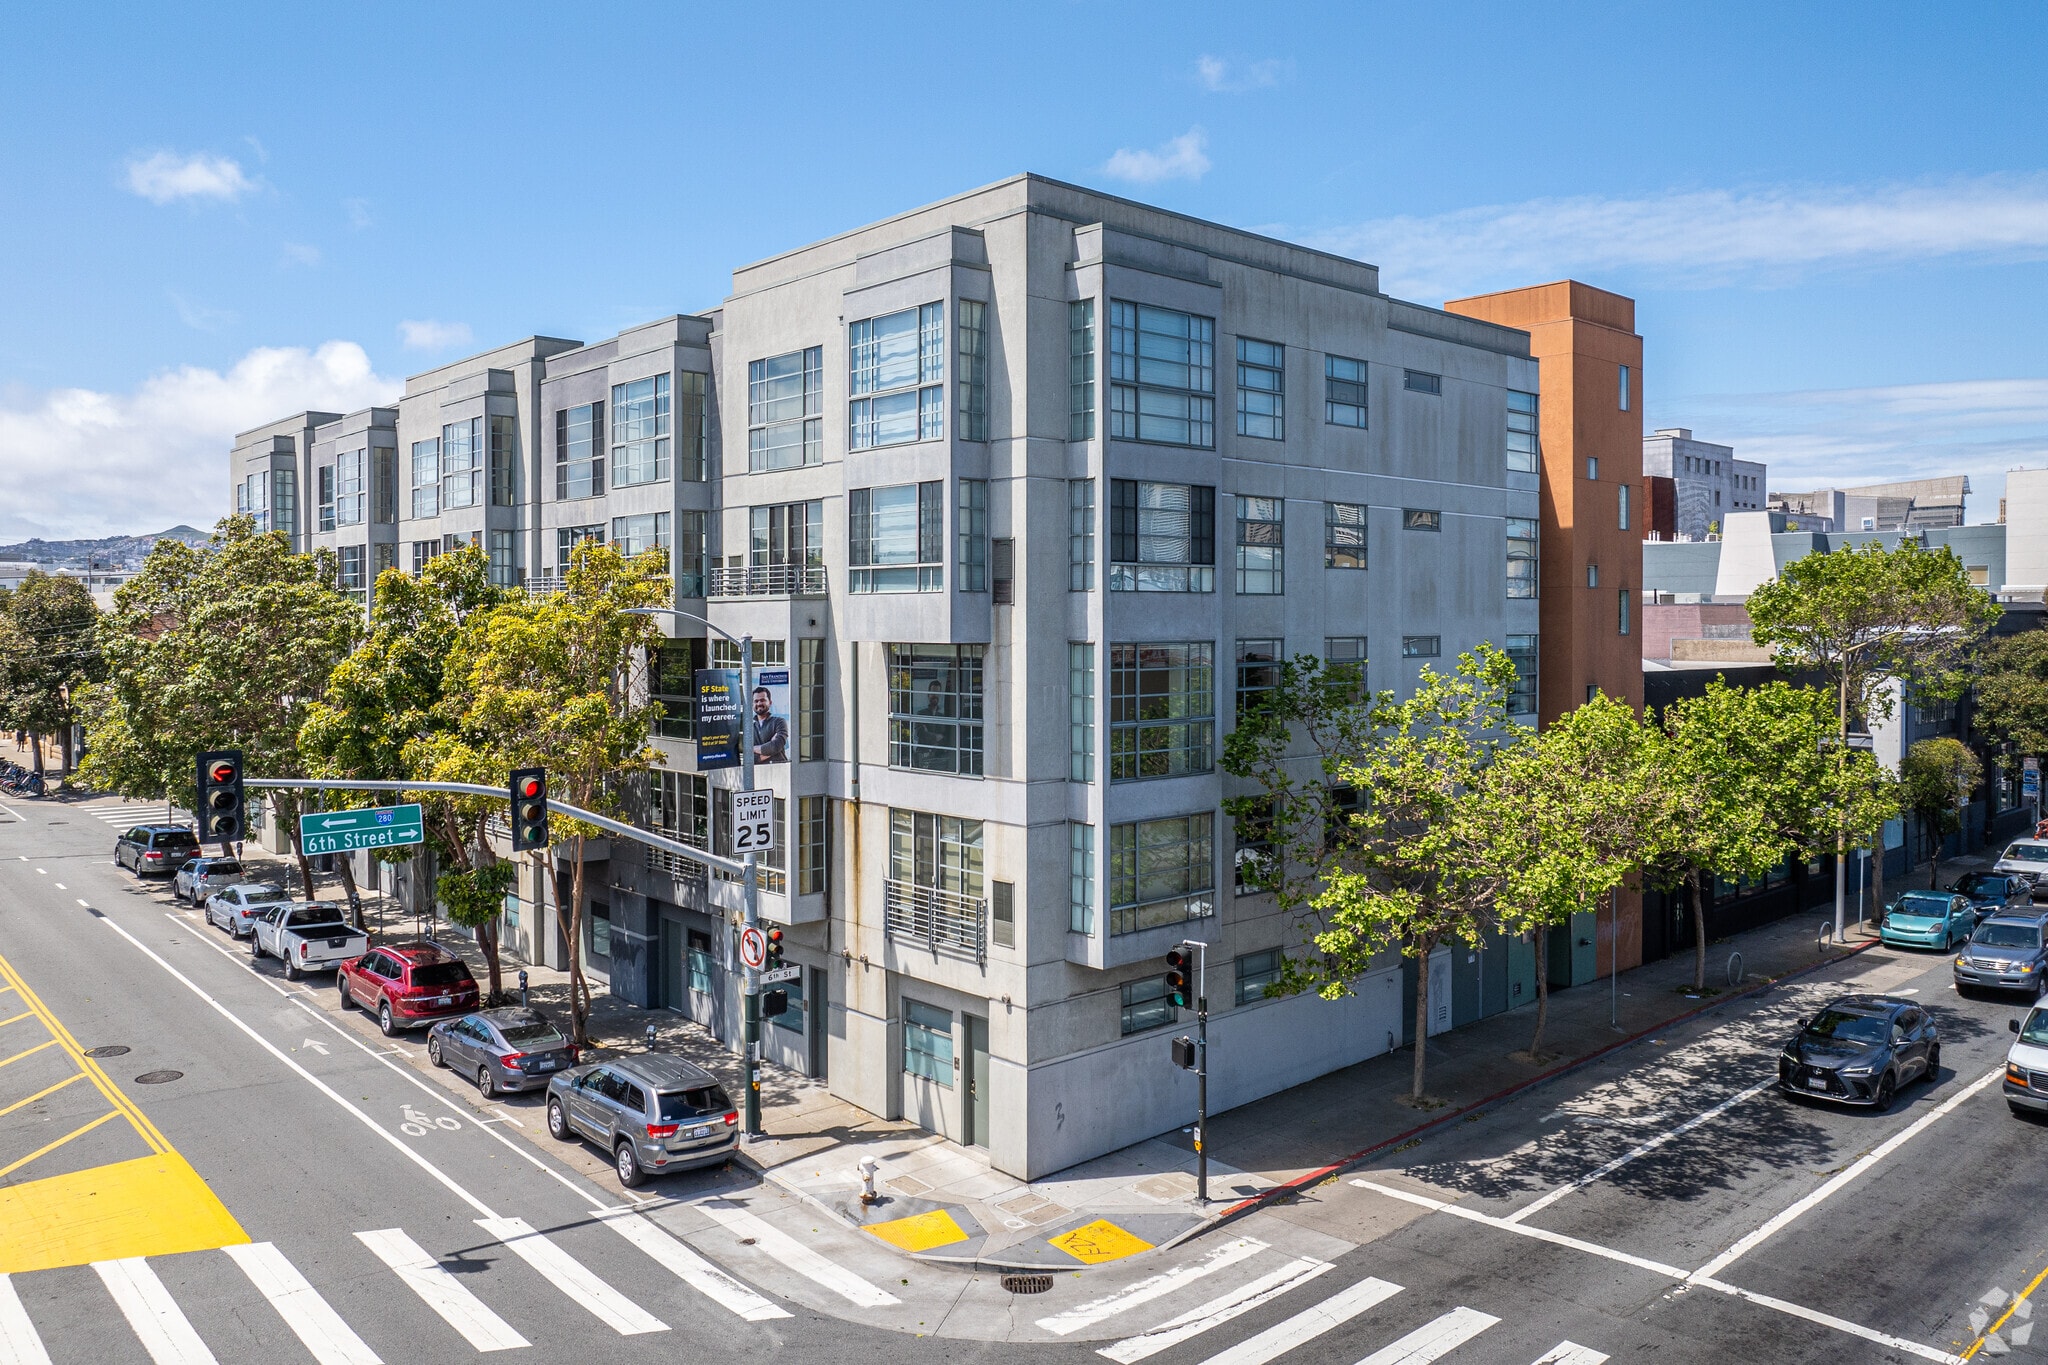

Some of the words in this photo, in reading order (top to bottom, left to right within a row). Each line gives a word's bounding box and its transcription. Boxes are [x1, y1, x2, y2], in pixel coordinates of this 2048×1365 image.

[701, 685, 710, 693] SF
[711, 685, 729, 693] State
[701, 695, 708, 703] is
[708, 694, 730, 702] where
[705, 703, 737, 712] launched
[701, 715, 712, 723] my
[736, 795, 770, 807] SPEED
[378, 814, 392, 823] 280
[740, 809, 767, 821] LIMIT
[308, 835, 337, 852] 6th
[344, 829, 394, 848] Street
[737, 823, 771, 848] 25
[768, 972, 779, 981] 6th
[784, 970, 792, 978] St
